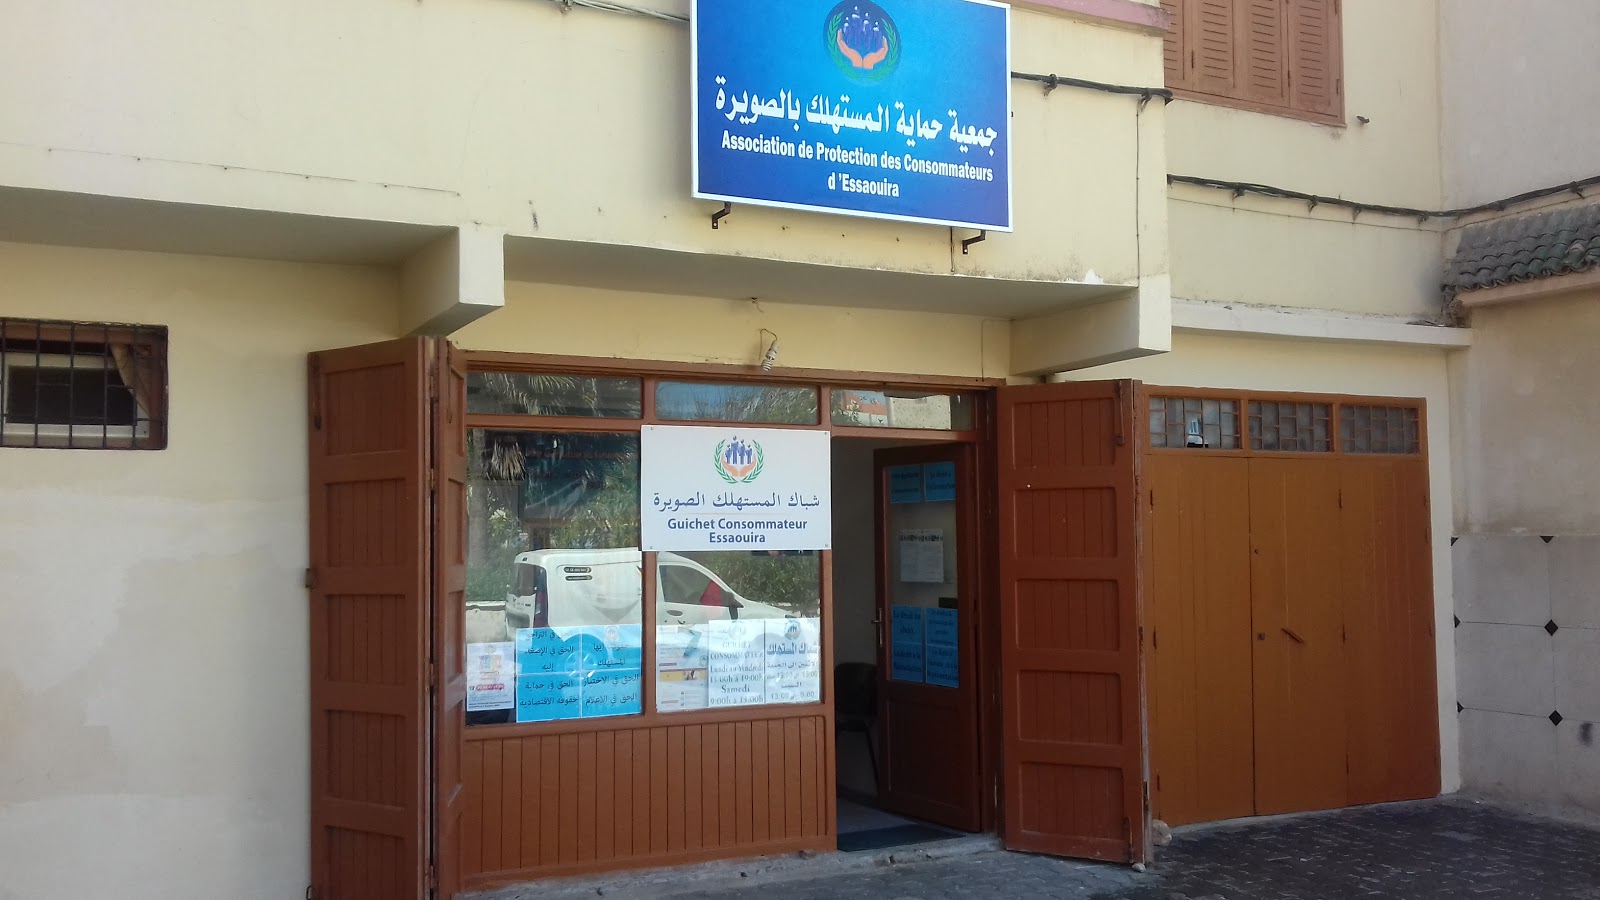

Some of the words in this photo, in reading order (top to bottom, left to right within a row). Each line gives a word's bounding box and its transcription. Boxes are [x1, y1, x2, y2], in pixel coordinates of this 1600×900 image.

[715, 75, 801, 132] بالصويرة
[805, 93, 890, 135] المستهلك
[894, 100, 943, 147] حماية
[948, 108, 998, 157] جمعية
[721, 129, 795, 158] Association
[797, 139, 814, 160] de
[816, 142, 878, 169] Protection
[880, 150, 902, 171] des
[903, 153, 994, 183] Consommateurs
[653, 491, 705, 512] الصويرة
[712, 491, 781, 511] المستهلك
[787, 491, 820, 510] شباك
[667, 518, 715, 530] Guichet
[718, 518, 808, 530] Consommateur
[709, 531, 766, 543] Essaouira
[721, 684, 750, 693] Samedi
